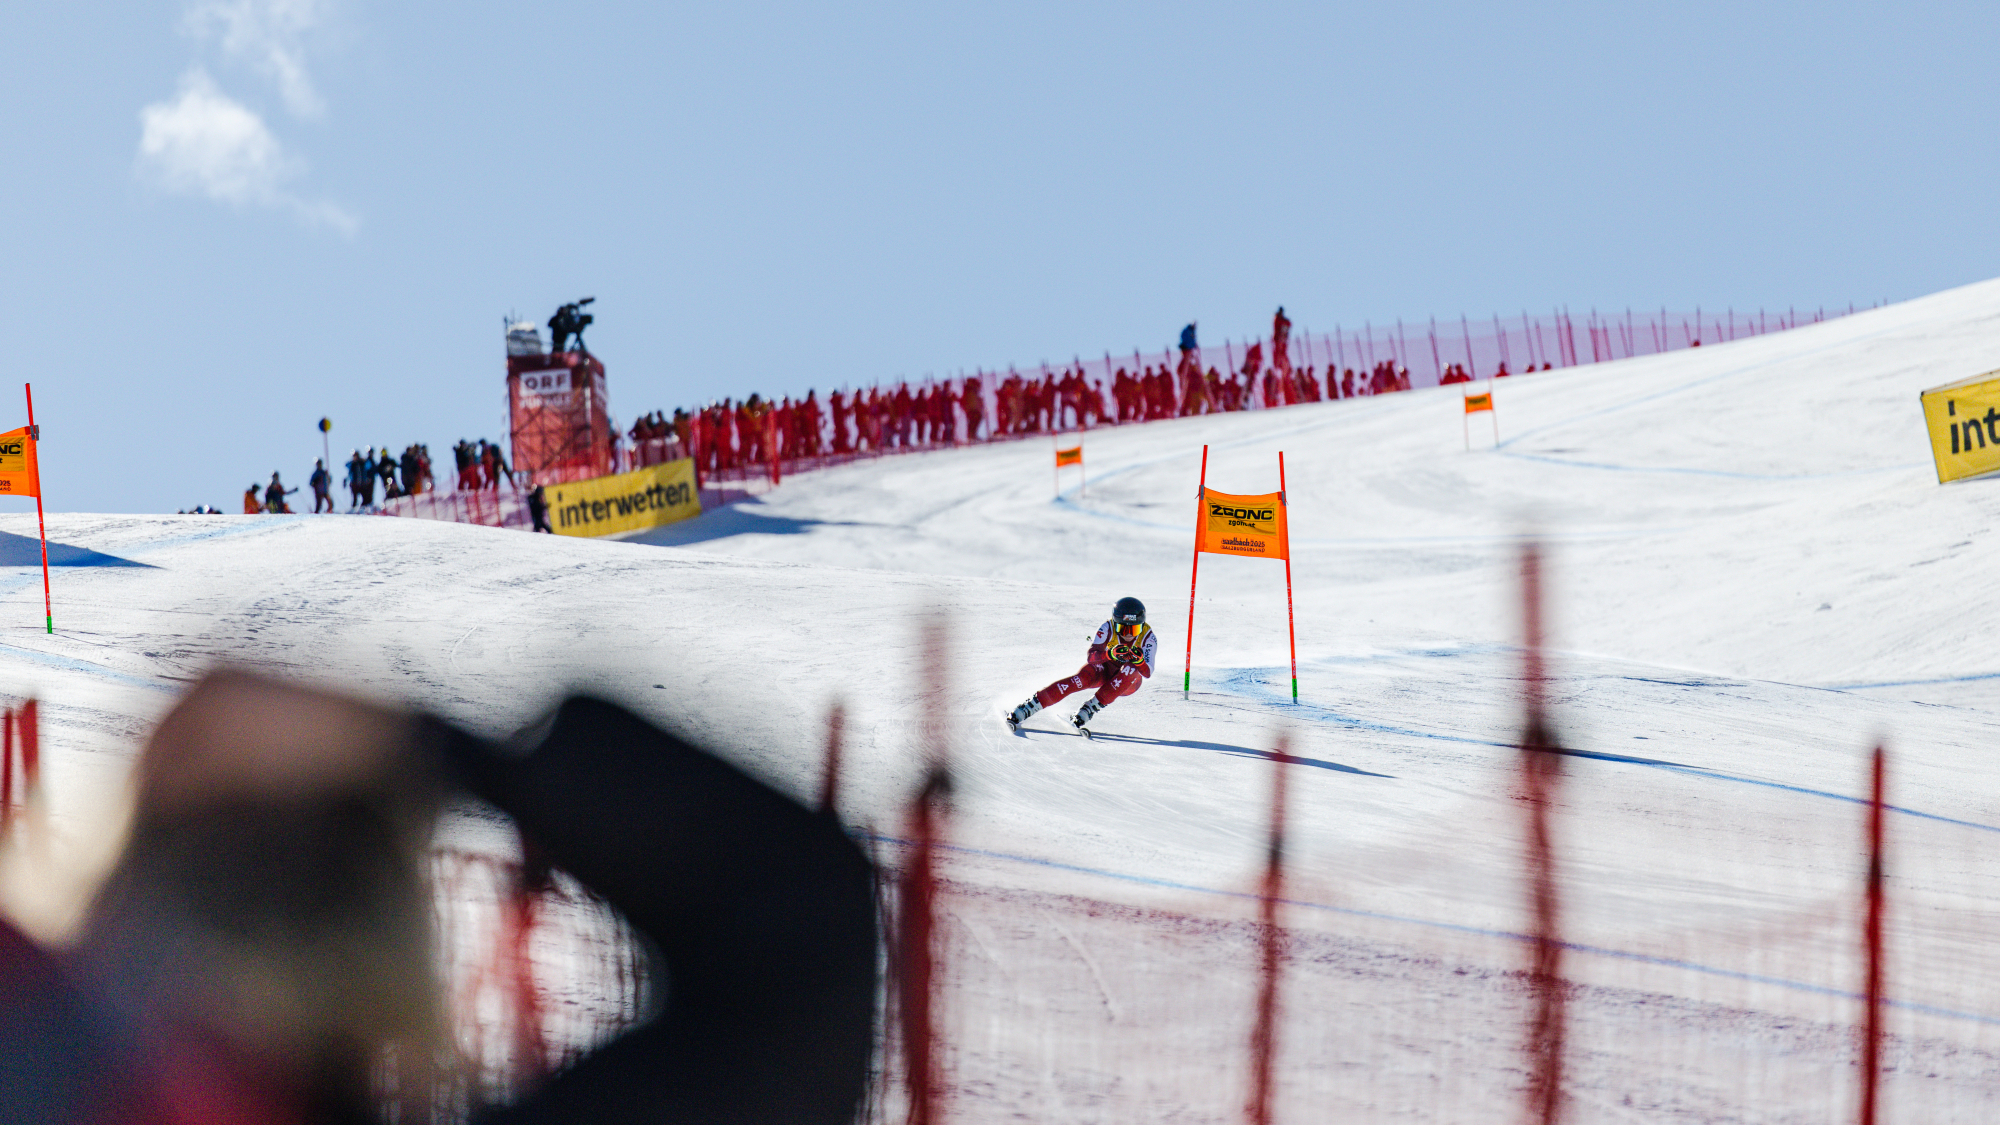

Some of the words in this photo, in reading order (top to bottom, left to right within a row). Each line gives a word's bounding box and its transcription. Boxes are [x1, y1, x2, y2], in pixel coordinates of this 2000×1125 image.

[525, 374, 567, 390] ORF
[557, 481, 690, 527] interwetten
[1211, 505, 1272, 520] ZGONC
